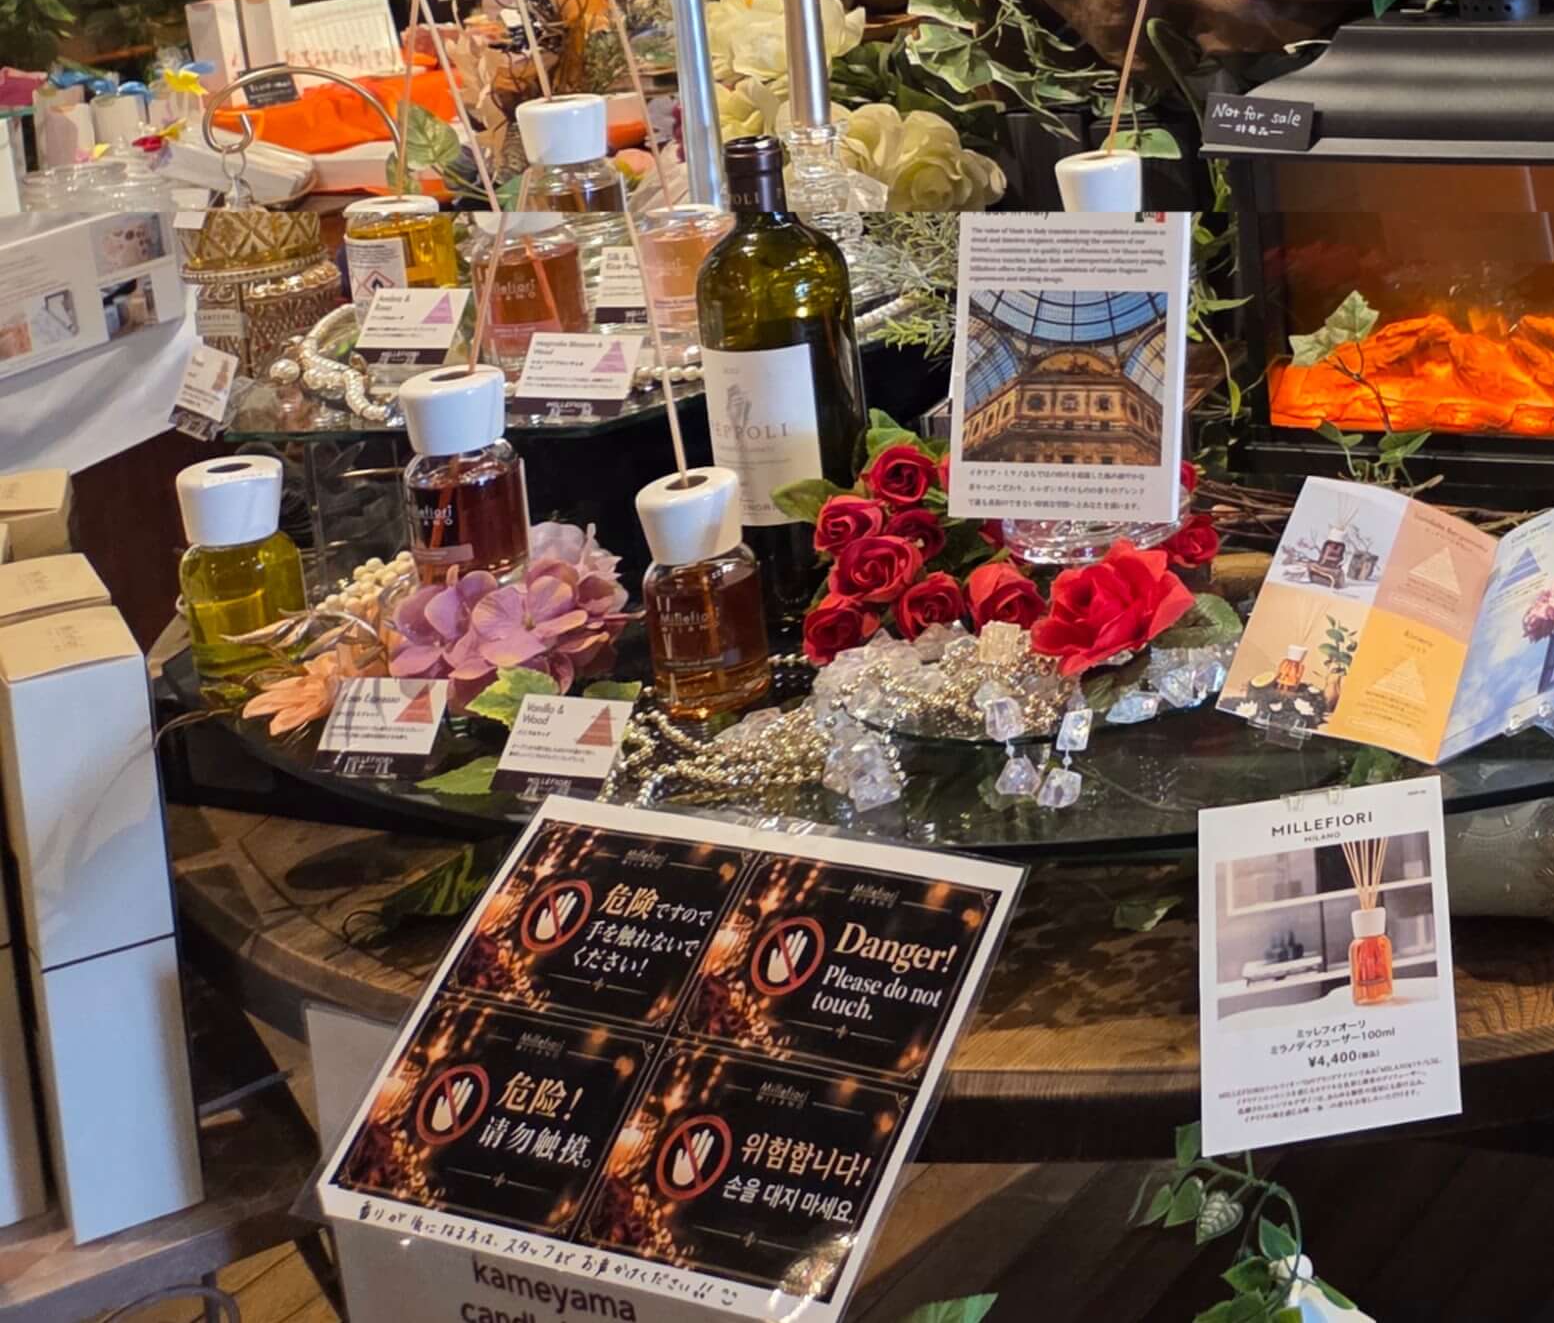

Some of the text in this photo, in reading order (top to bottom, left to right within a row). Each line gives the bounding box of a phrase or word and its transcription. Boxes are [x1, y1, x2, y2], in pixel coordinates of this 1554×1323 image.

[1212, 103, 1302, 127] Not for sale
[715, 422, 788, 441] EPPOLI
[522, 712, 550, 726] Wood
[527, 701, 556, 714] Vanilla
[1272, 811, 1373, 837] MILLEFIORI
[1304, 831, 1341, 843] MILANO
[598, 883, 713, 926] 危険ですので
[586, 920, 700, 957] 手を触れないで
[833, 922, 958, 974] Danger!
[574, 945, 649, 977] ください!
[822, 964, 943, 1008] Please do not
[811, 991, 873, 1020] touch.
[1270, 1027, 1396, 1055] ミラノディフューザー100ml
[1297, 1020, 1366, 1039] ミッレフィオーリ
[496, 1072, 583, 1120] 危险!
[479, 1116, 591, 1168] 请勿触摸。
[741, 1132, 871, 1187] 위험합니다!
[722, 1175, 853, 1224] 손을 대지 마세요.
[472, 1255, 637, 1323] kameyama
